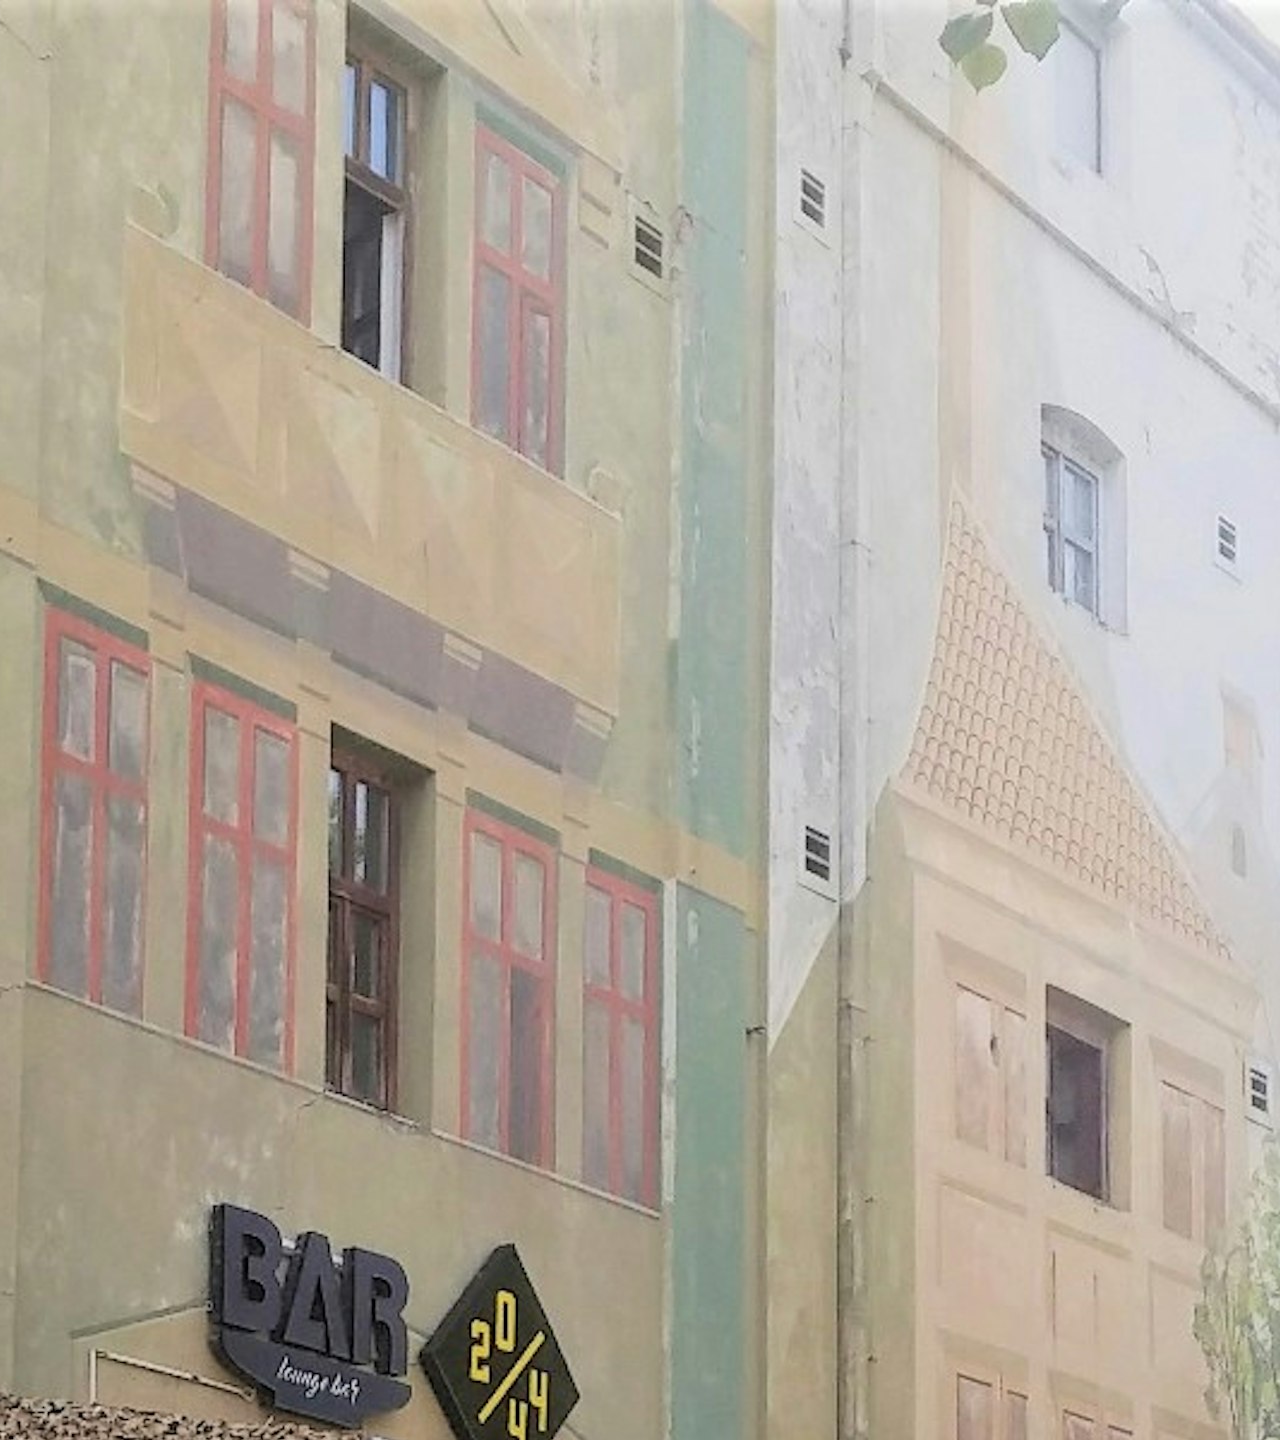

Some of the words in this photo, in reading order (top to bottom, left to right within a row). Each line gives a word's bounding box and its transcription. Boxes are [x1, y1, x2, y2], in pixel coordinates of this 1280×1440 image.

[214, 1202, 409, 1377] BAR
[276, 1355, 329, 1399] lounge
[330, 1372, 360, 1406] bar
